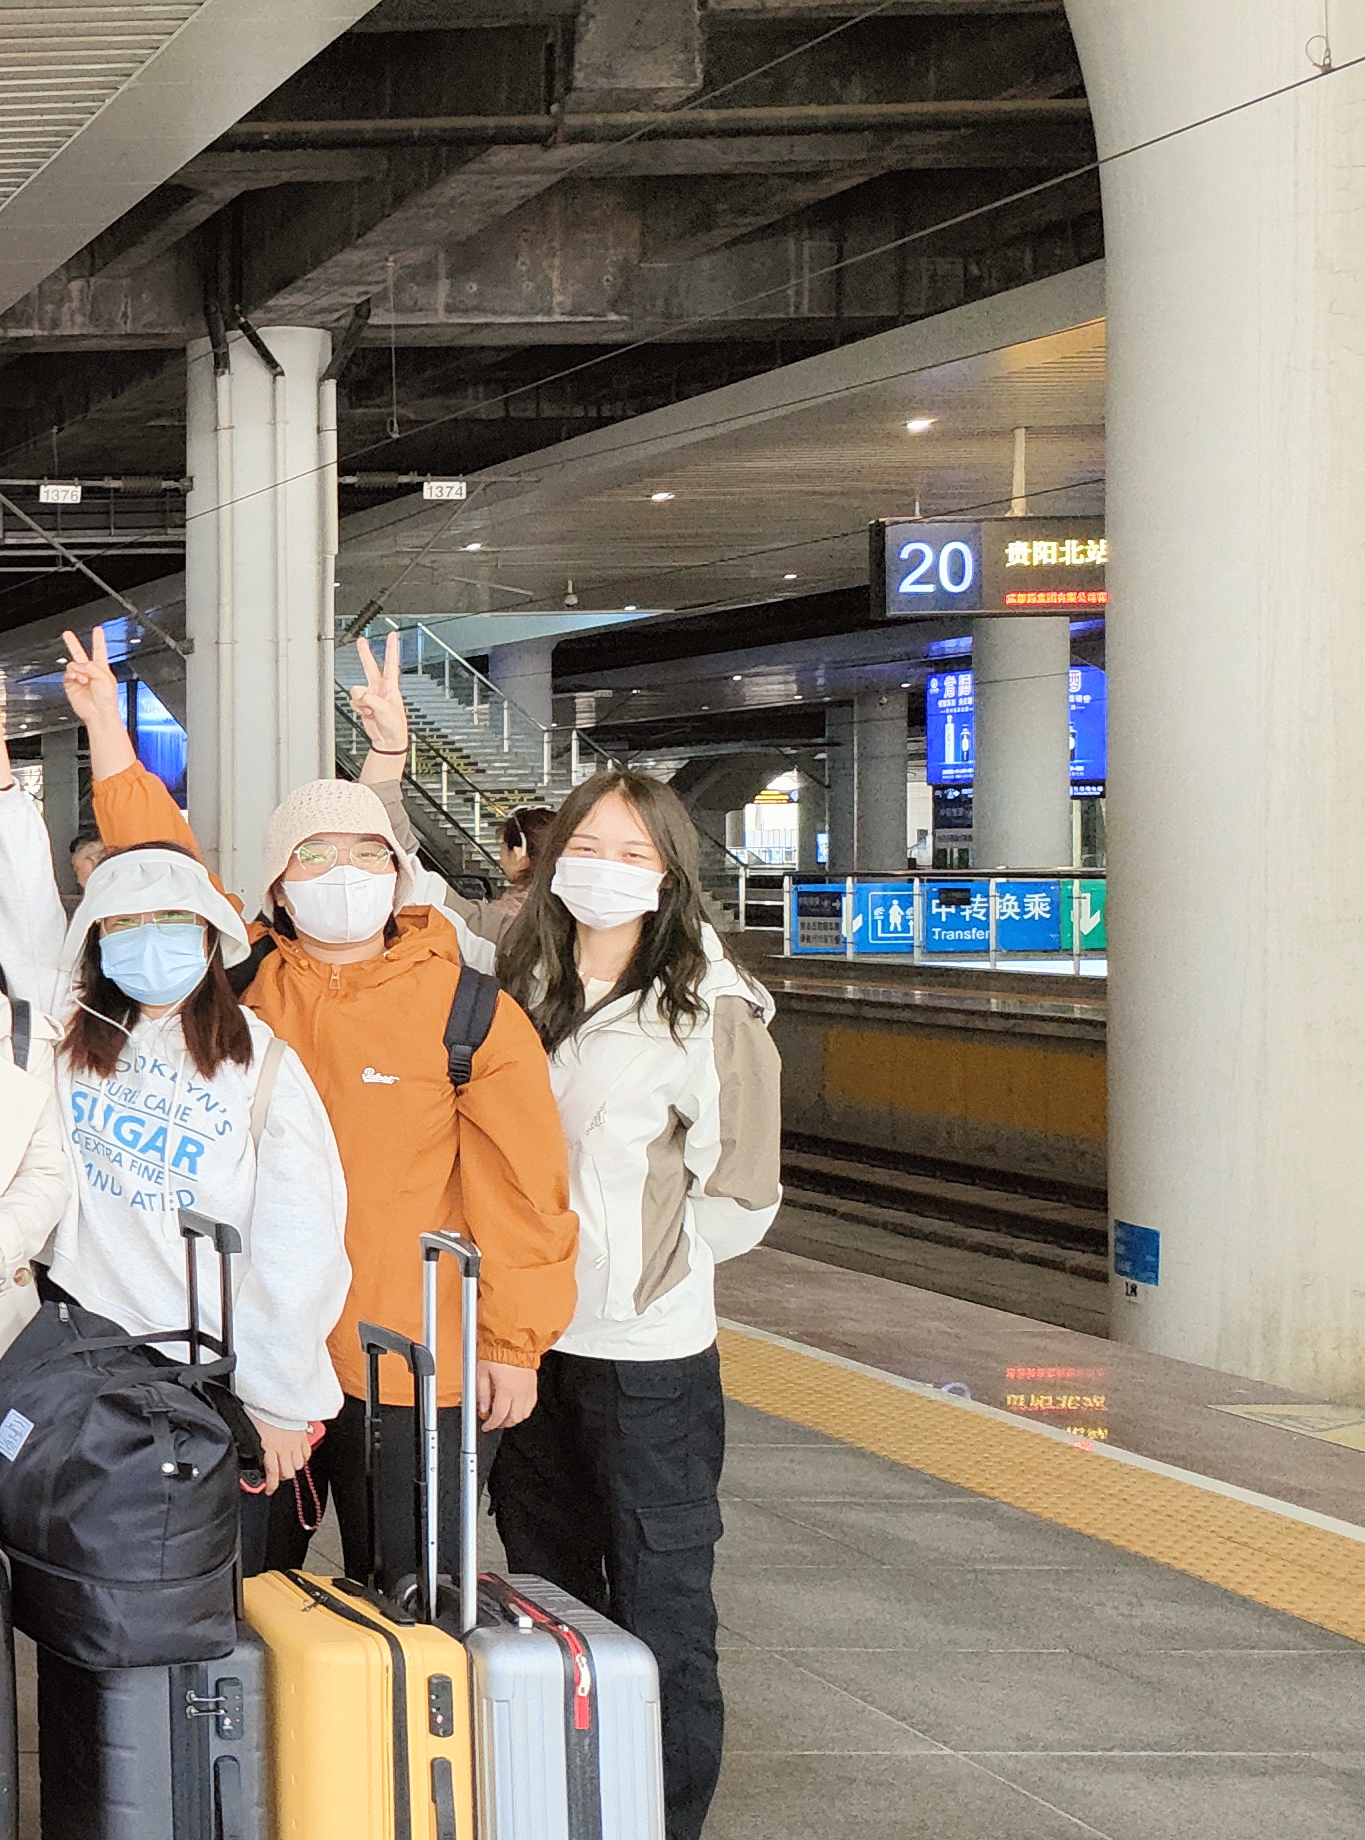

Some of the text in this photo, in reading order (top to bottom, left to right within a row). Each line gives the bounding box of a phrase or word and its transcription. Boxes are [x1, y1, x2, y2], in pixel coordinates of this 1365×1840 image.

[44, 489, 79, 502] 1376
[427, 486, 463, 498] 1374
[898, 541, 973, 593] 20
[931, 893, 1052, 922] 中转换乘
[931, 927, 990, 941] Transfer
[71, 1090, 205, 1175] SUGAR
[84, 1136, 165, 1186] EXTRA FINE
